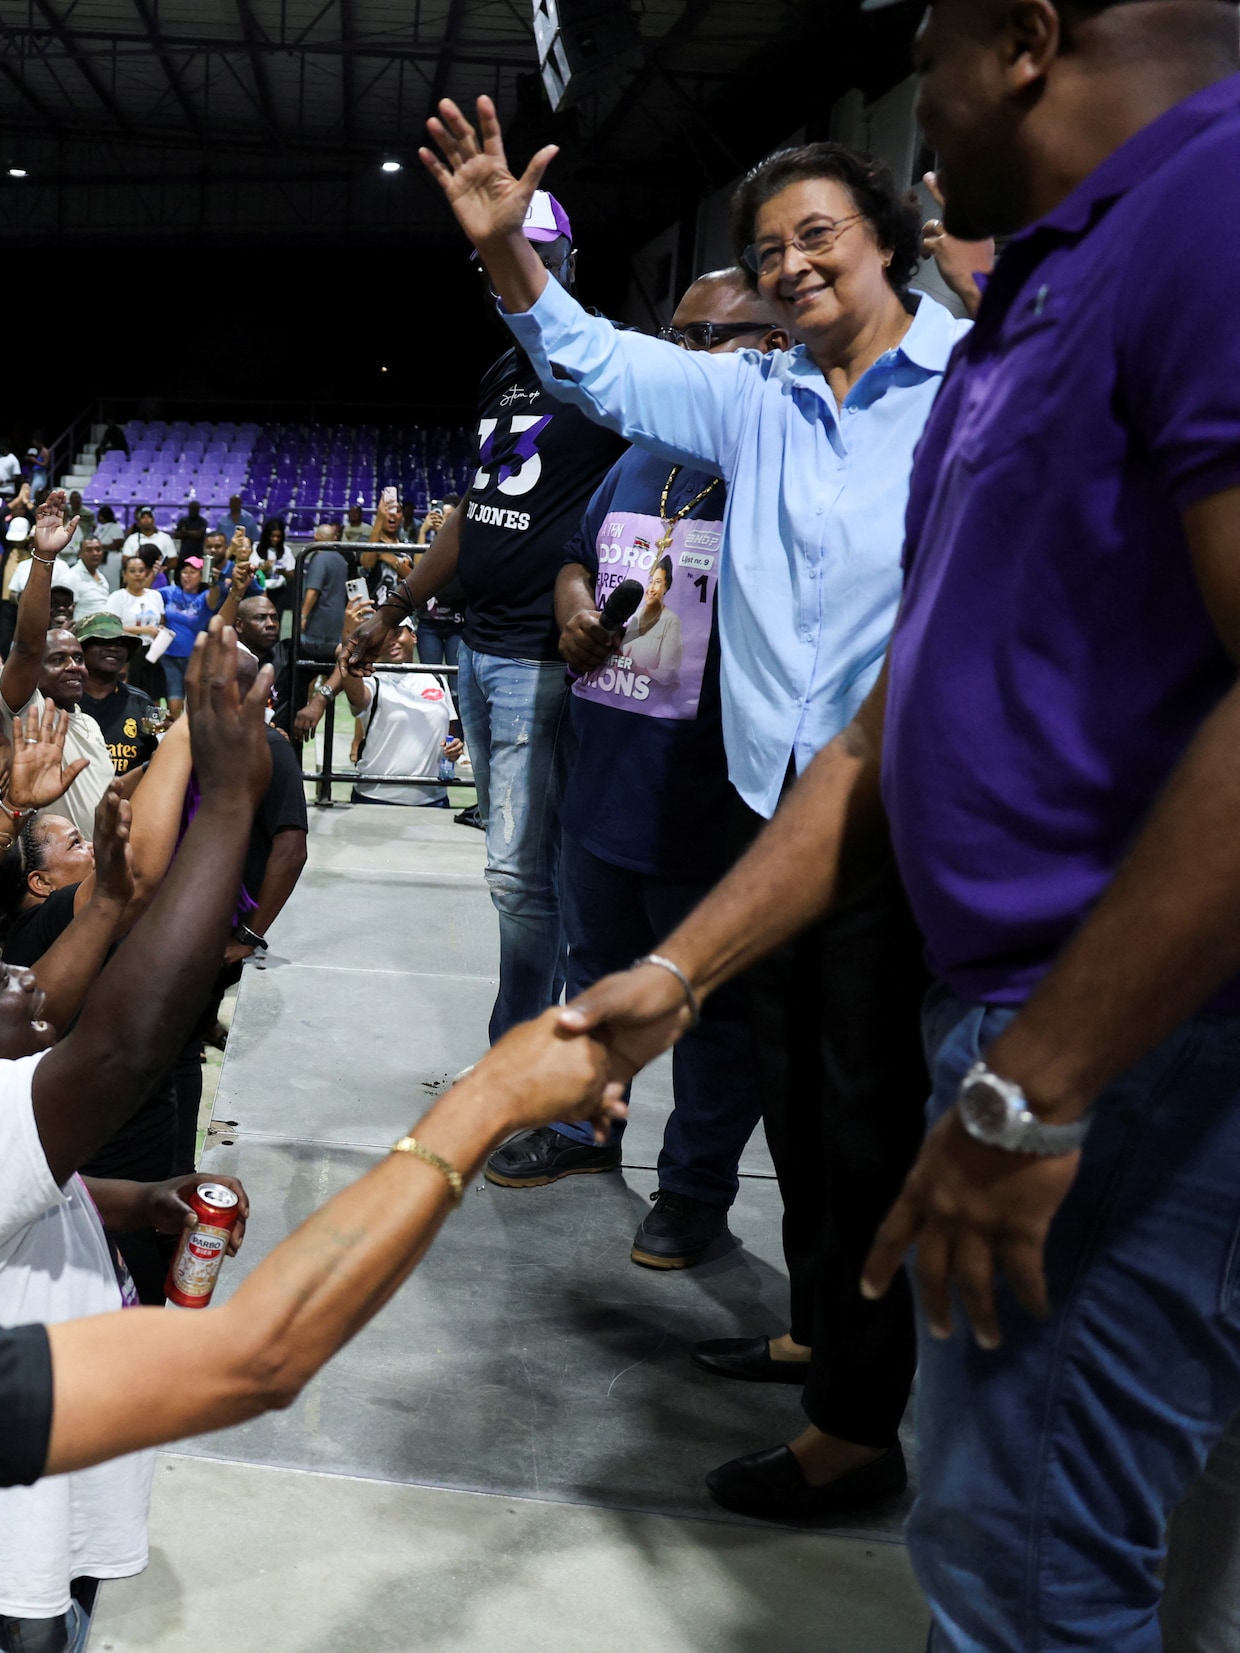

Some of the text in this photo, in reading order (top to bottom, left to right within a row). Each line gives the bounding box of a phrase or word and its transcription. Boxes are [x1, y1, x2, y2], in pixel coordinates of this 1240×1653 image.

[475, 504, 531, 531] JONES
[681, 555, 693, 565] Lijst
[703, 558, 710, 566] 9
[694, 575, 709, 604] 1
[191, 1236, 221, 1249] PARBO
